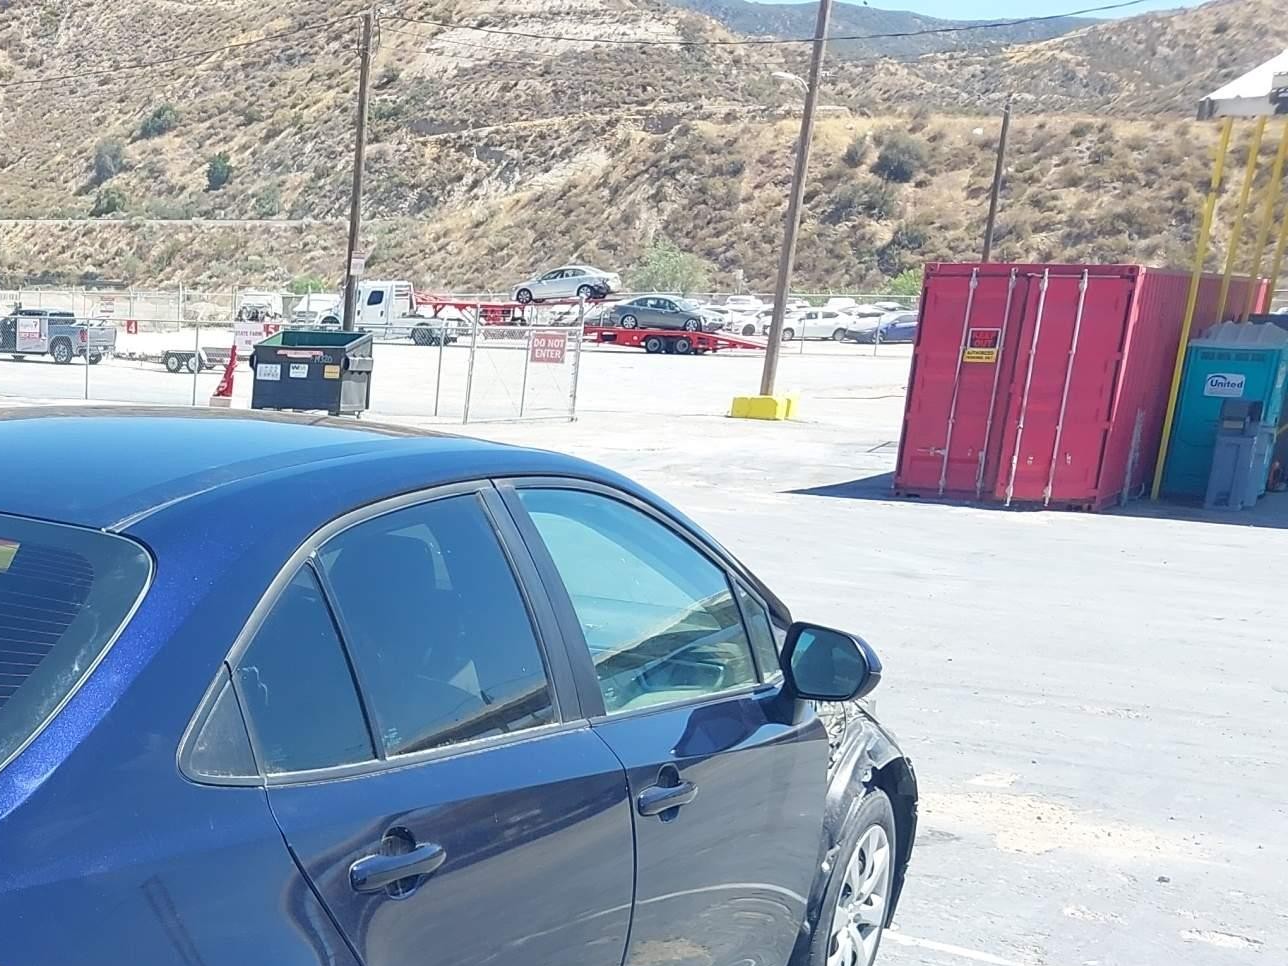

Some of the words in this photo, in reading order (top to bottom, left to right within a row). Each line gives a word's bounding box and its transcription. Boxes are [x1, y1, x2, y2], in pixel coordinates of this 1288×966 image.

[128, 320, 136, 334] 4
[533, 338, 546, 348] DO
[547, 338, 565, 348] NOT
[535, 348, 561, 359] ENTER
[1210, 379, 1244, 388] United
